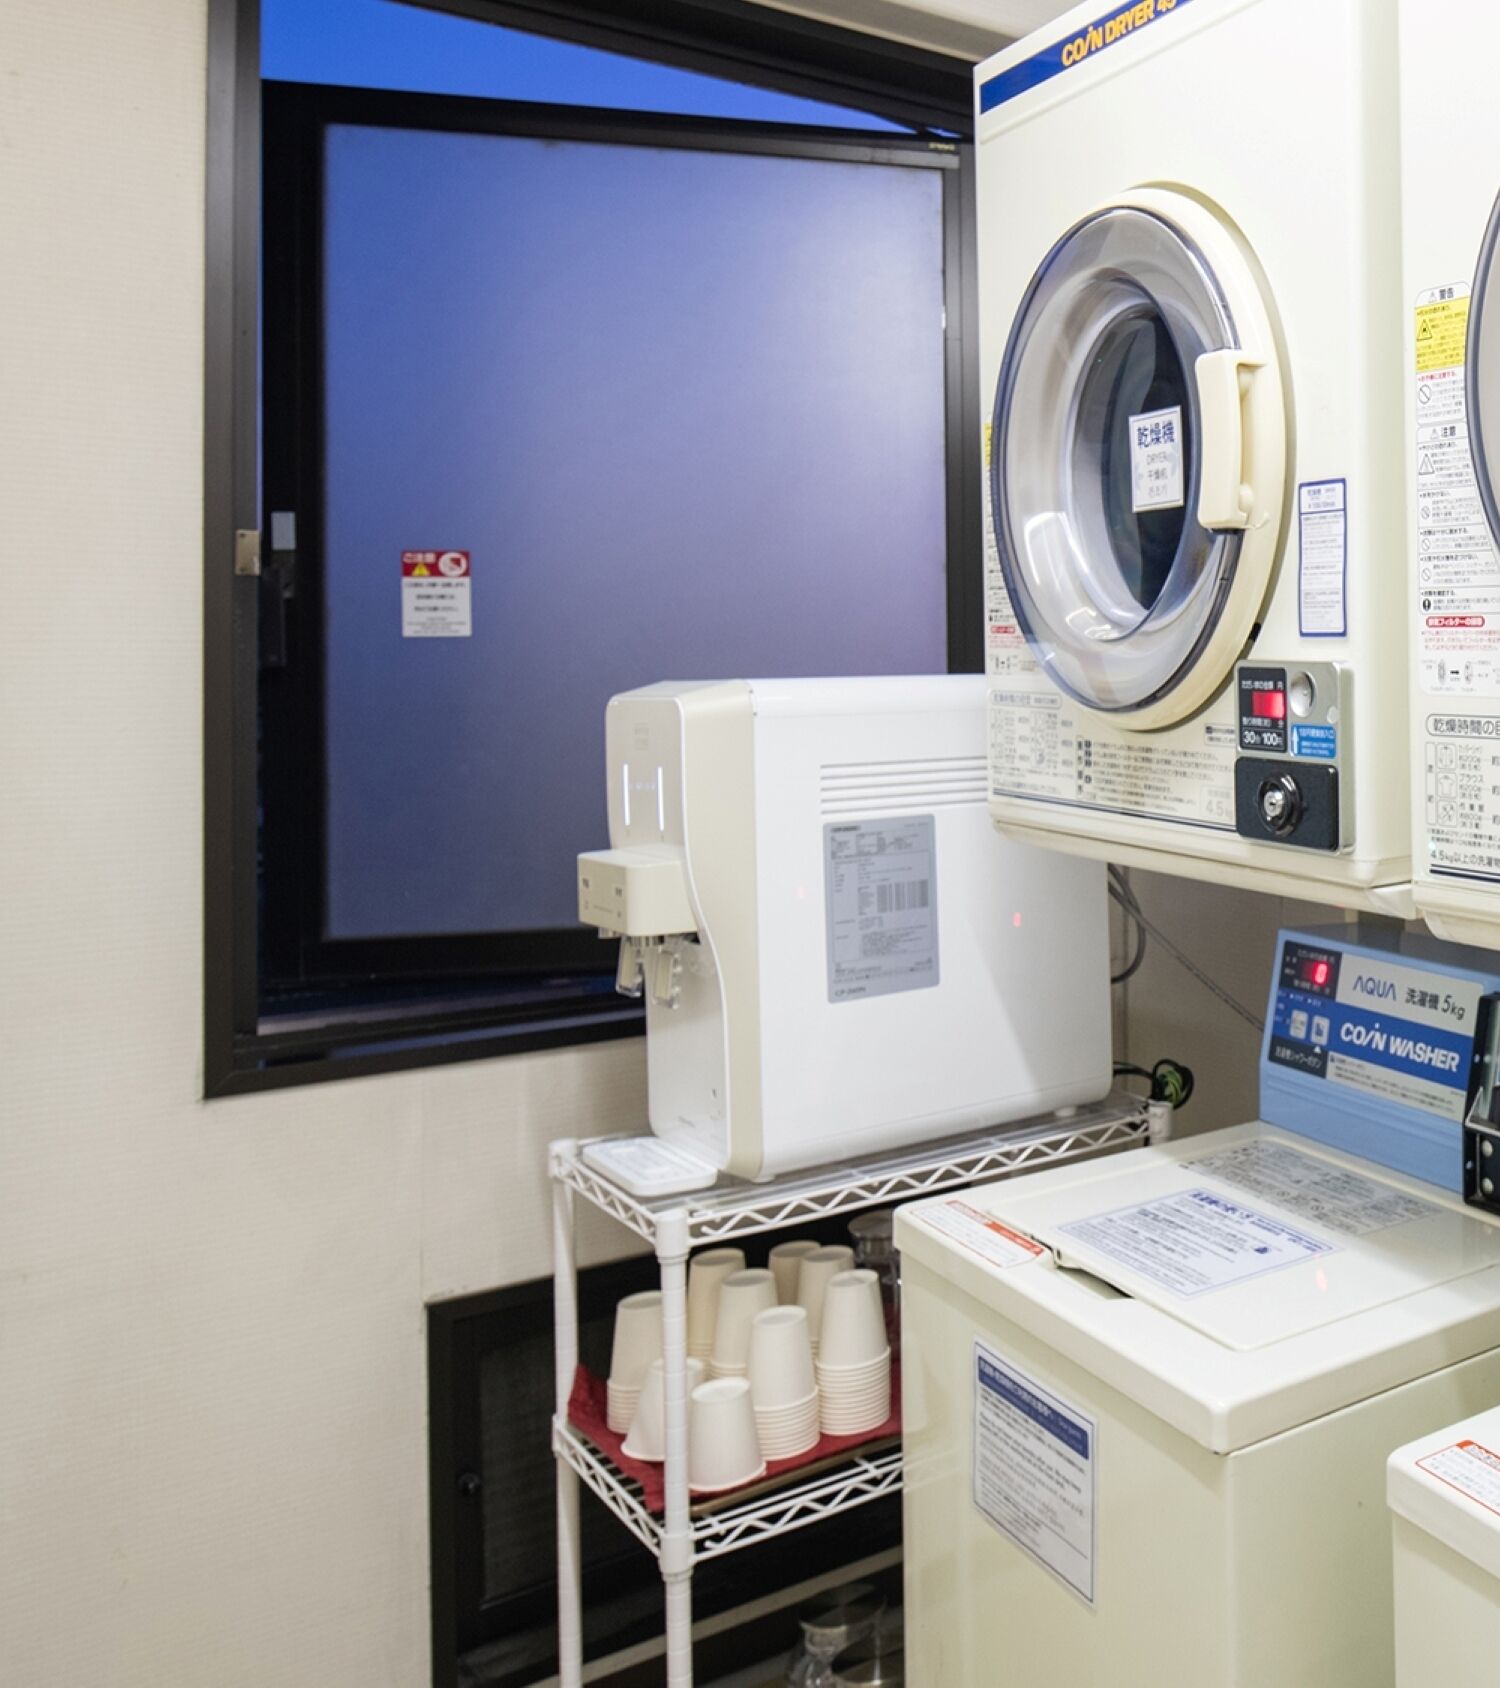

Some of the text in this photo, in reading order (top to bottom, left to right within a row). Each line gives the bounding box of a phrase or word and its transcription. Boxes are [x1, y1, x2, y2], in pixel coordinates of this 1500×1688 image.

[1061, 25, 1103, 67] COIN
[1104, 1, 1155, 43] DRYER
[1352, 975, 1397, 1001] AQUA
[1405, 987, 1440, 1011] 洗濯機
[1389, 1034, 1461, 1073] WASHER
